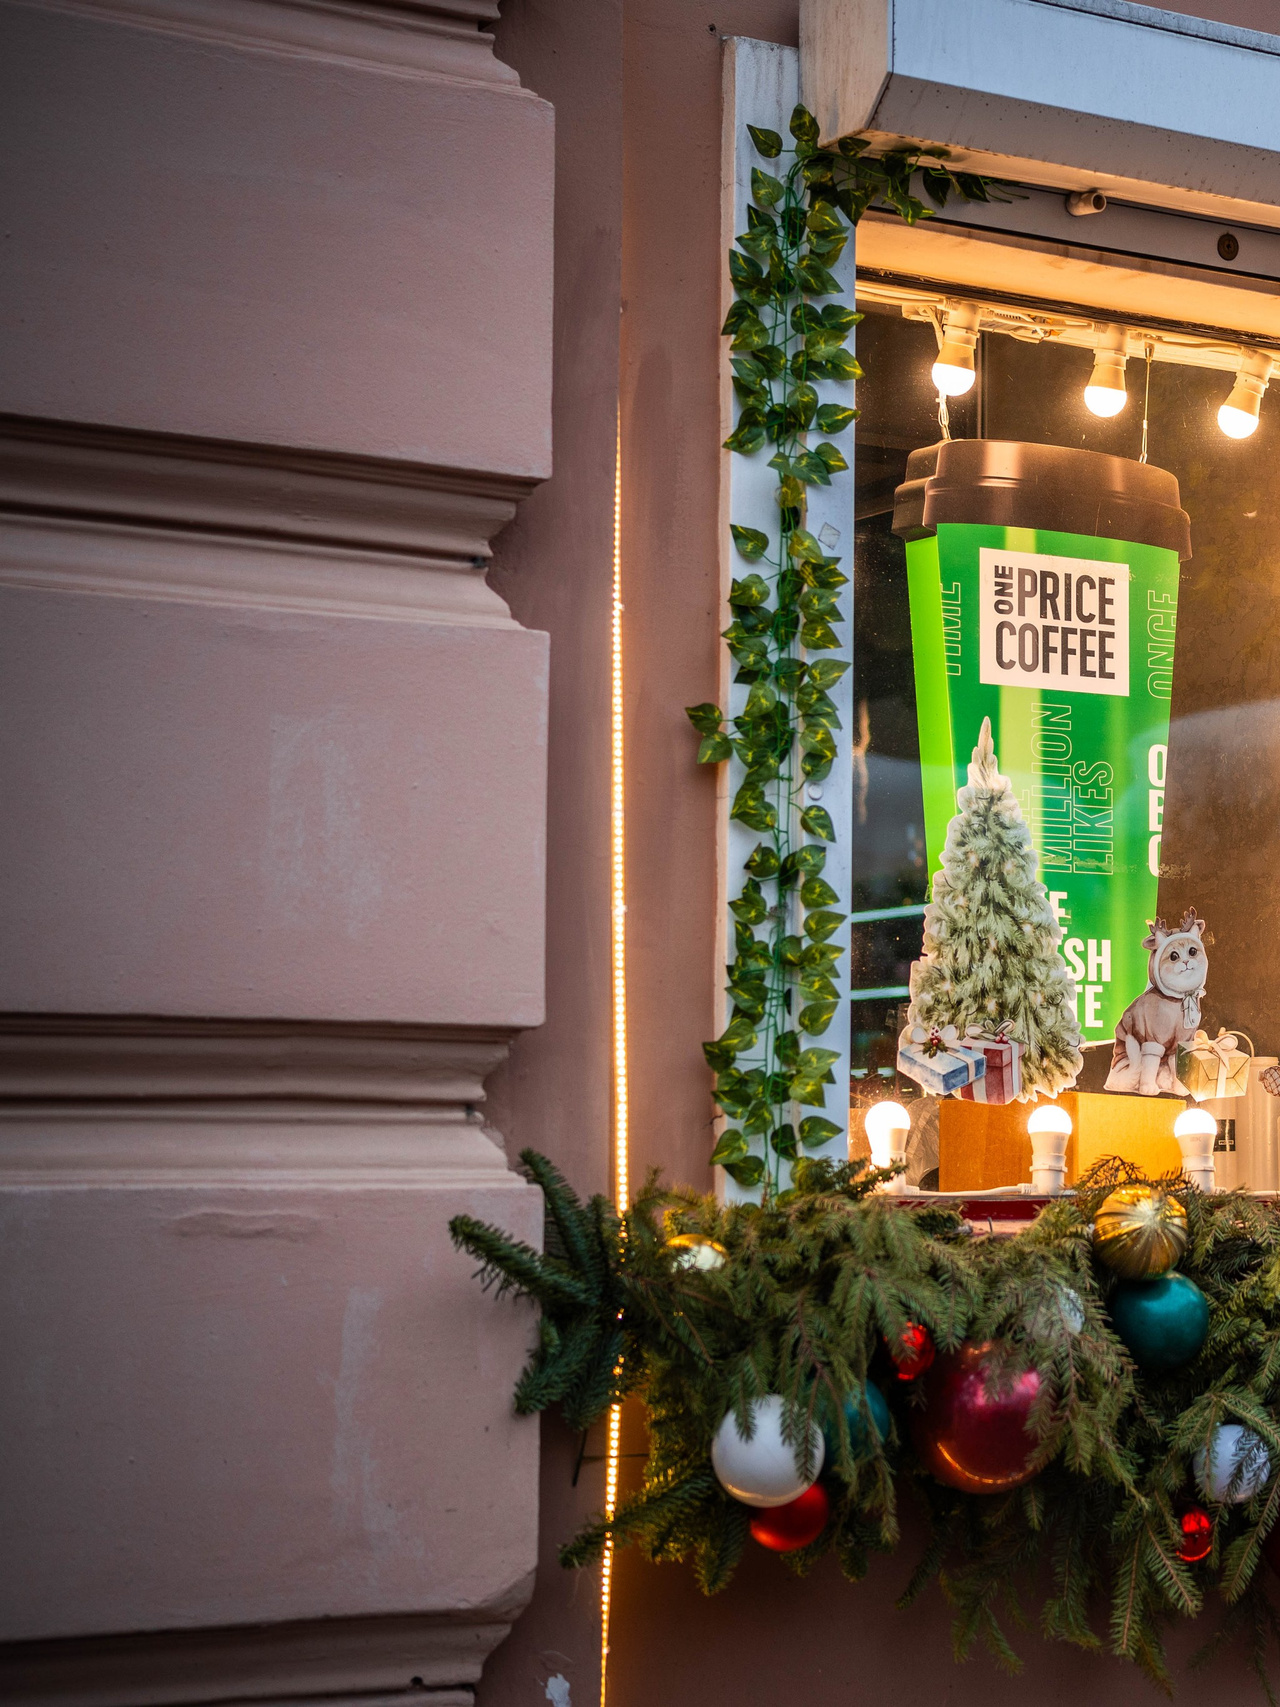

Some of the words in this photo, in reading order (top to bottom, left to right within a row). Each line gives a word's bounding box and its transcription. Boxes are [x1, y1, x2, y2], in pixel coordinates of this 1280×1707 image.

[994, 565, 1014, 615] ONE
[1017, 567, 1116, 626] PRICE
[995, 620, 1116, 680] COFFEE
[1031, 702, 1073, 874] MILLION
[1073, 760, 1114, 876] LIKES
